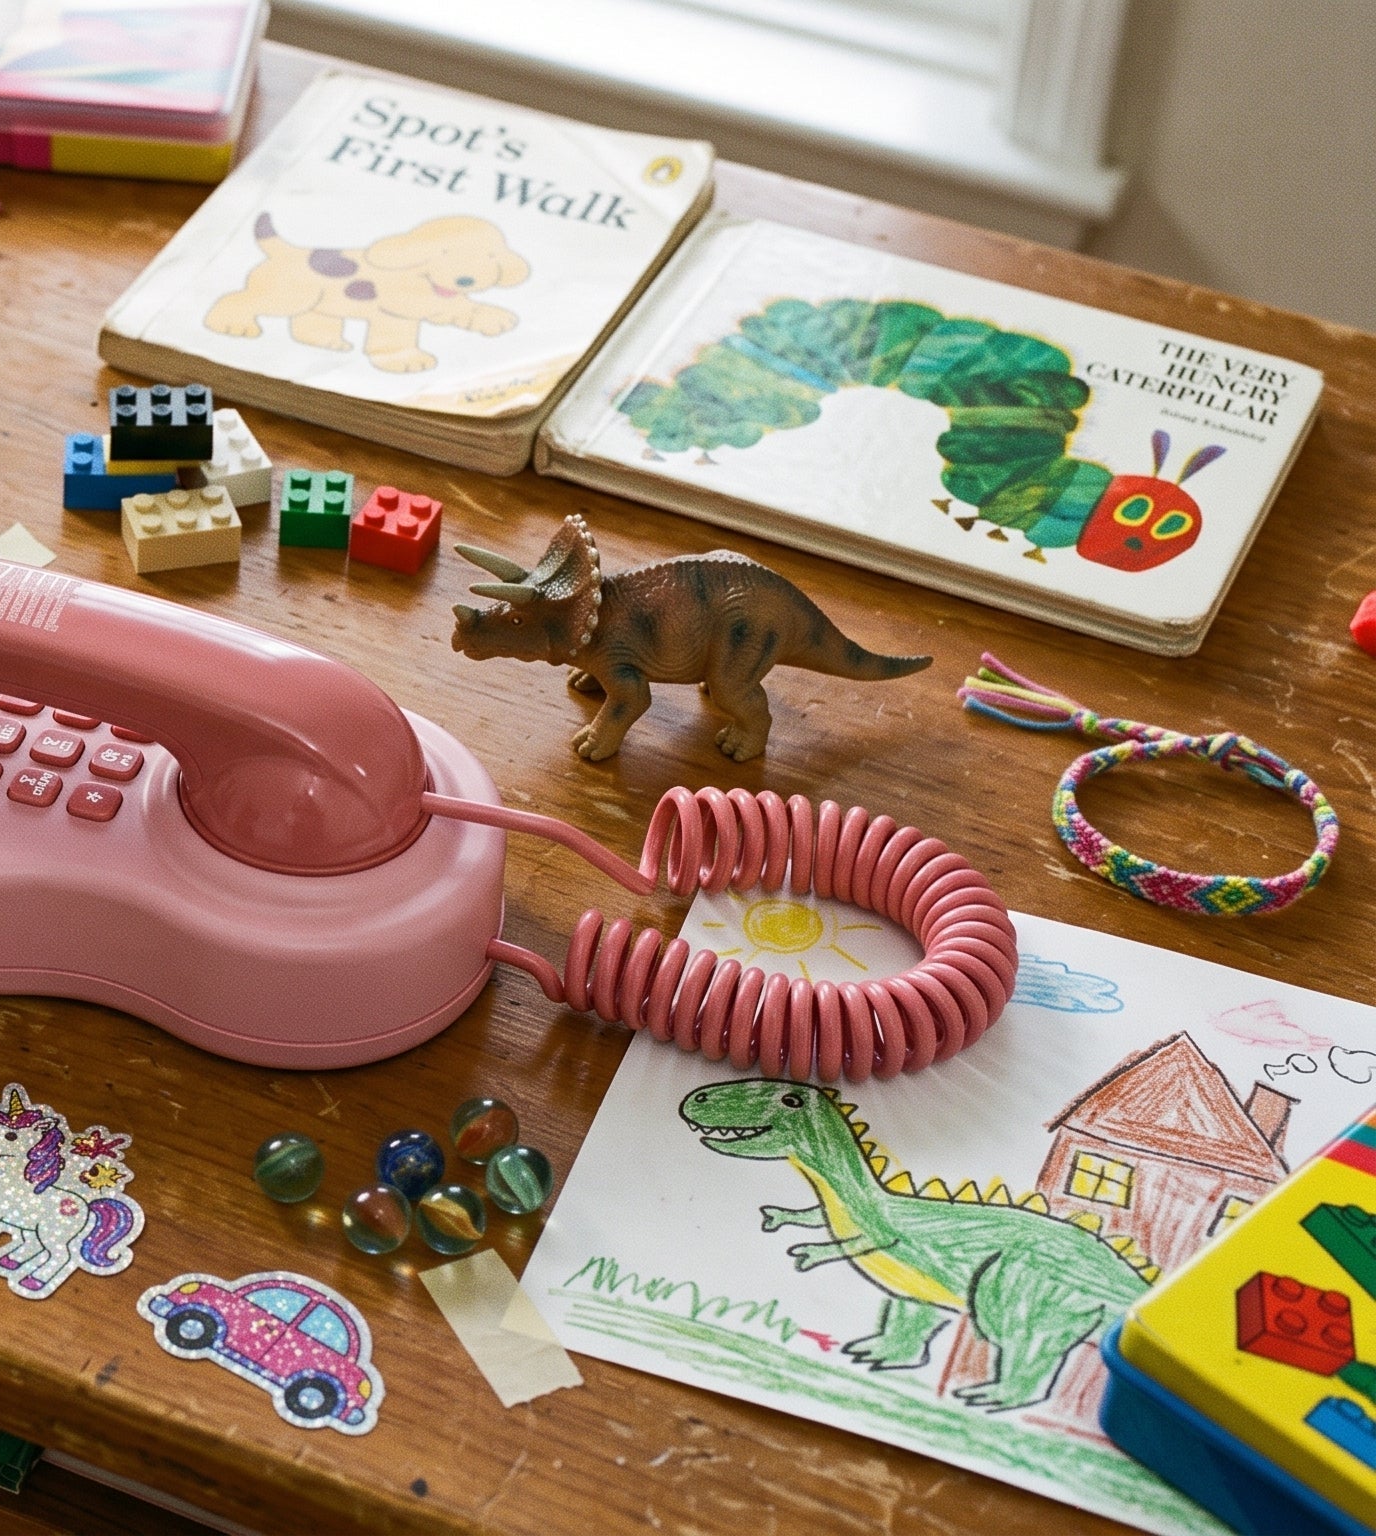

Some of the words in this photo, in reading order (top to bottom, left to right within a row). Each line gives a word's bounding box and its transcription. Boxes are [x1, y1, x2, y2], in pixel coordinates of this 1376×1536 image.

[353, 96, 529, 161] Spot's
[326, 135, 468, 194] First
[493, 172, 637, 231] Walk
[1086, 362, 1279, 426] CATERPILLAR
[1159, 340, 1216, 366] THE
[1223, 357, 1296, 389] VERY
[1166, 363, 1289, 406] HUNGRY
